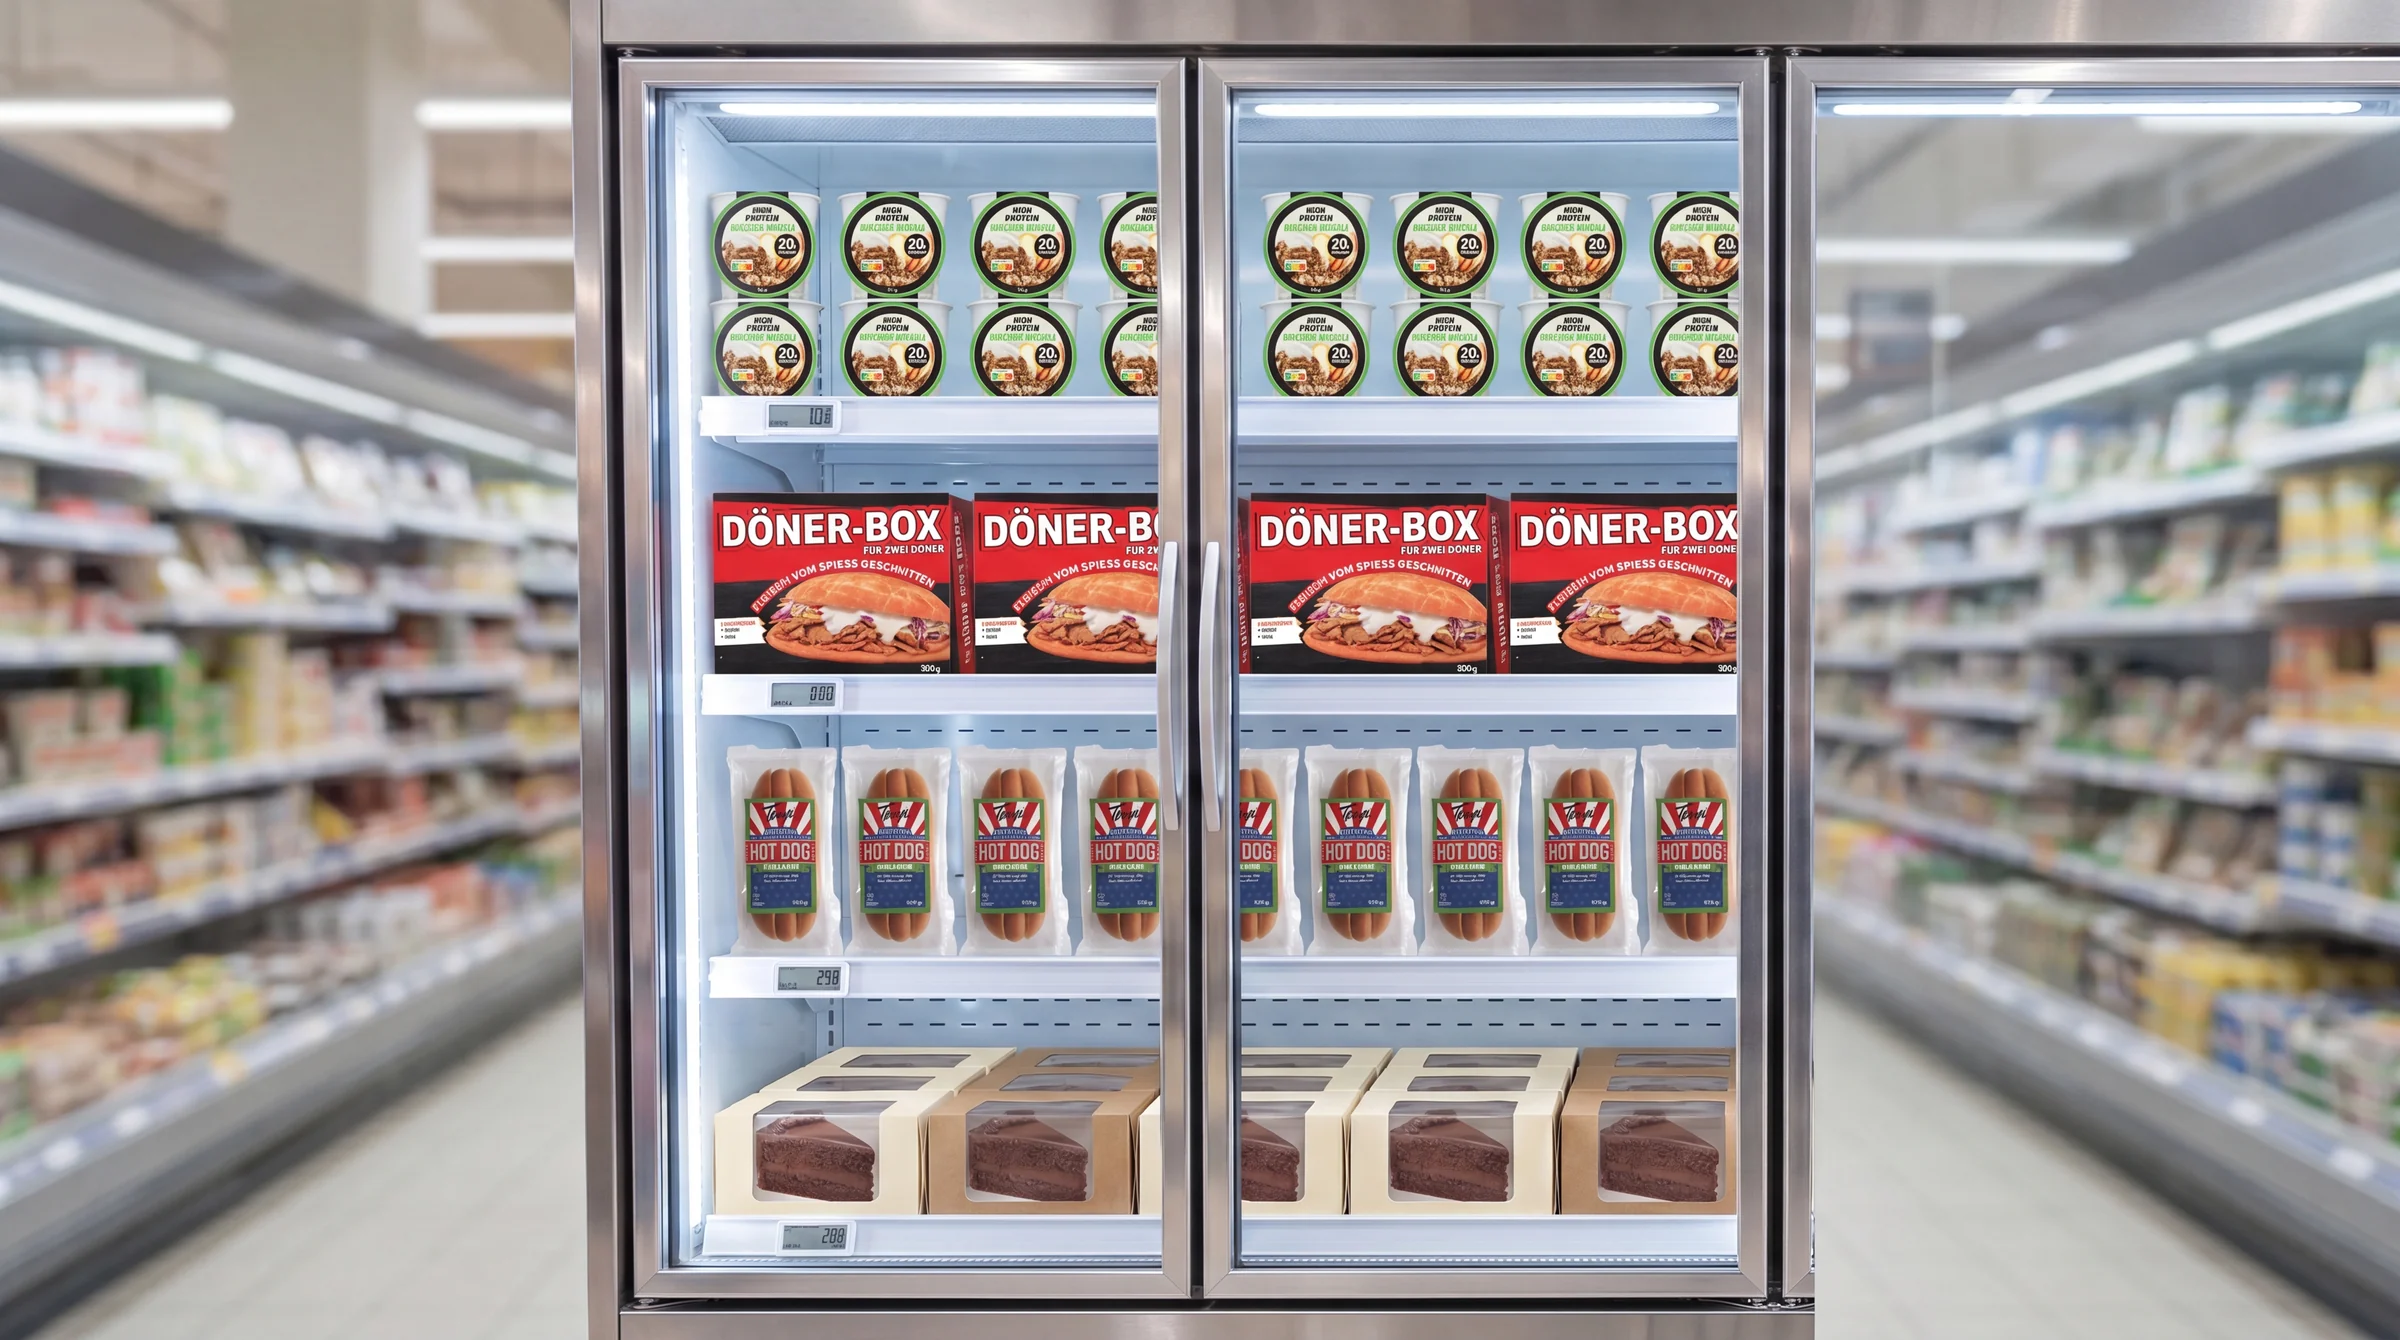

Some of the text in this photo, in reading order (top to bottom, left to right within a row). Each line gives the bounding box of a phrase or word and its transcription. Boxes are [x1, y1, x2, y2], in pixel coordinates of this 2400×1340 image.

[722, 507, 942, 547] DÖNER-BOX
[984, 507, 1159, 547] DÖNER-B
[1259, 507, 1480, 547] DÖNER-BOX
[1519, 507, 1737, 547] DÖNER-BOX
[791, 565, 817, 580] VOM
[819, 559, 859, 572] SPIESS
[860, 559, 936, 588] GESCHNITTEN
[1054, 565, 1079, 580] VOM
[1081, 559, 1121, 572] SPIESS
[1328, 565, 1354, 580] VOM
[1356, 559, 1396, 572] SPIESS
[1397, 559, 1472, 588] GESCHNITTEN
[1588, 565, 1615, 580] VOM
[1616, 559, 1656, 572] SPIESS
[1658, 559, 1733, 588] GESCHNITTEN
[750, 842, 810, 861] HOT DOG
[863, 842, 924, 861] HOT DOG
[978, 842, 1039, 861] HOT DOG
[1095, 842, 1156, 861] HOT DOG
[1242, 842, 1272, 861] DOG
[1325, 842, 1386, 861] HOT DOG
[1437, 842, 1497, 861] HOT DOG
[1550, 842, 1609, 861] HOT DOG
[1661, 842, 1722, 861] HOT DOG
